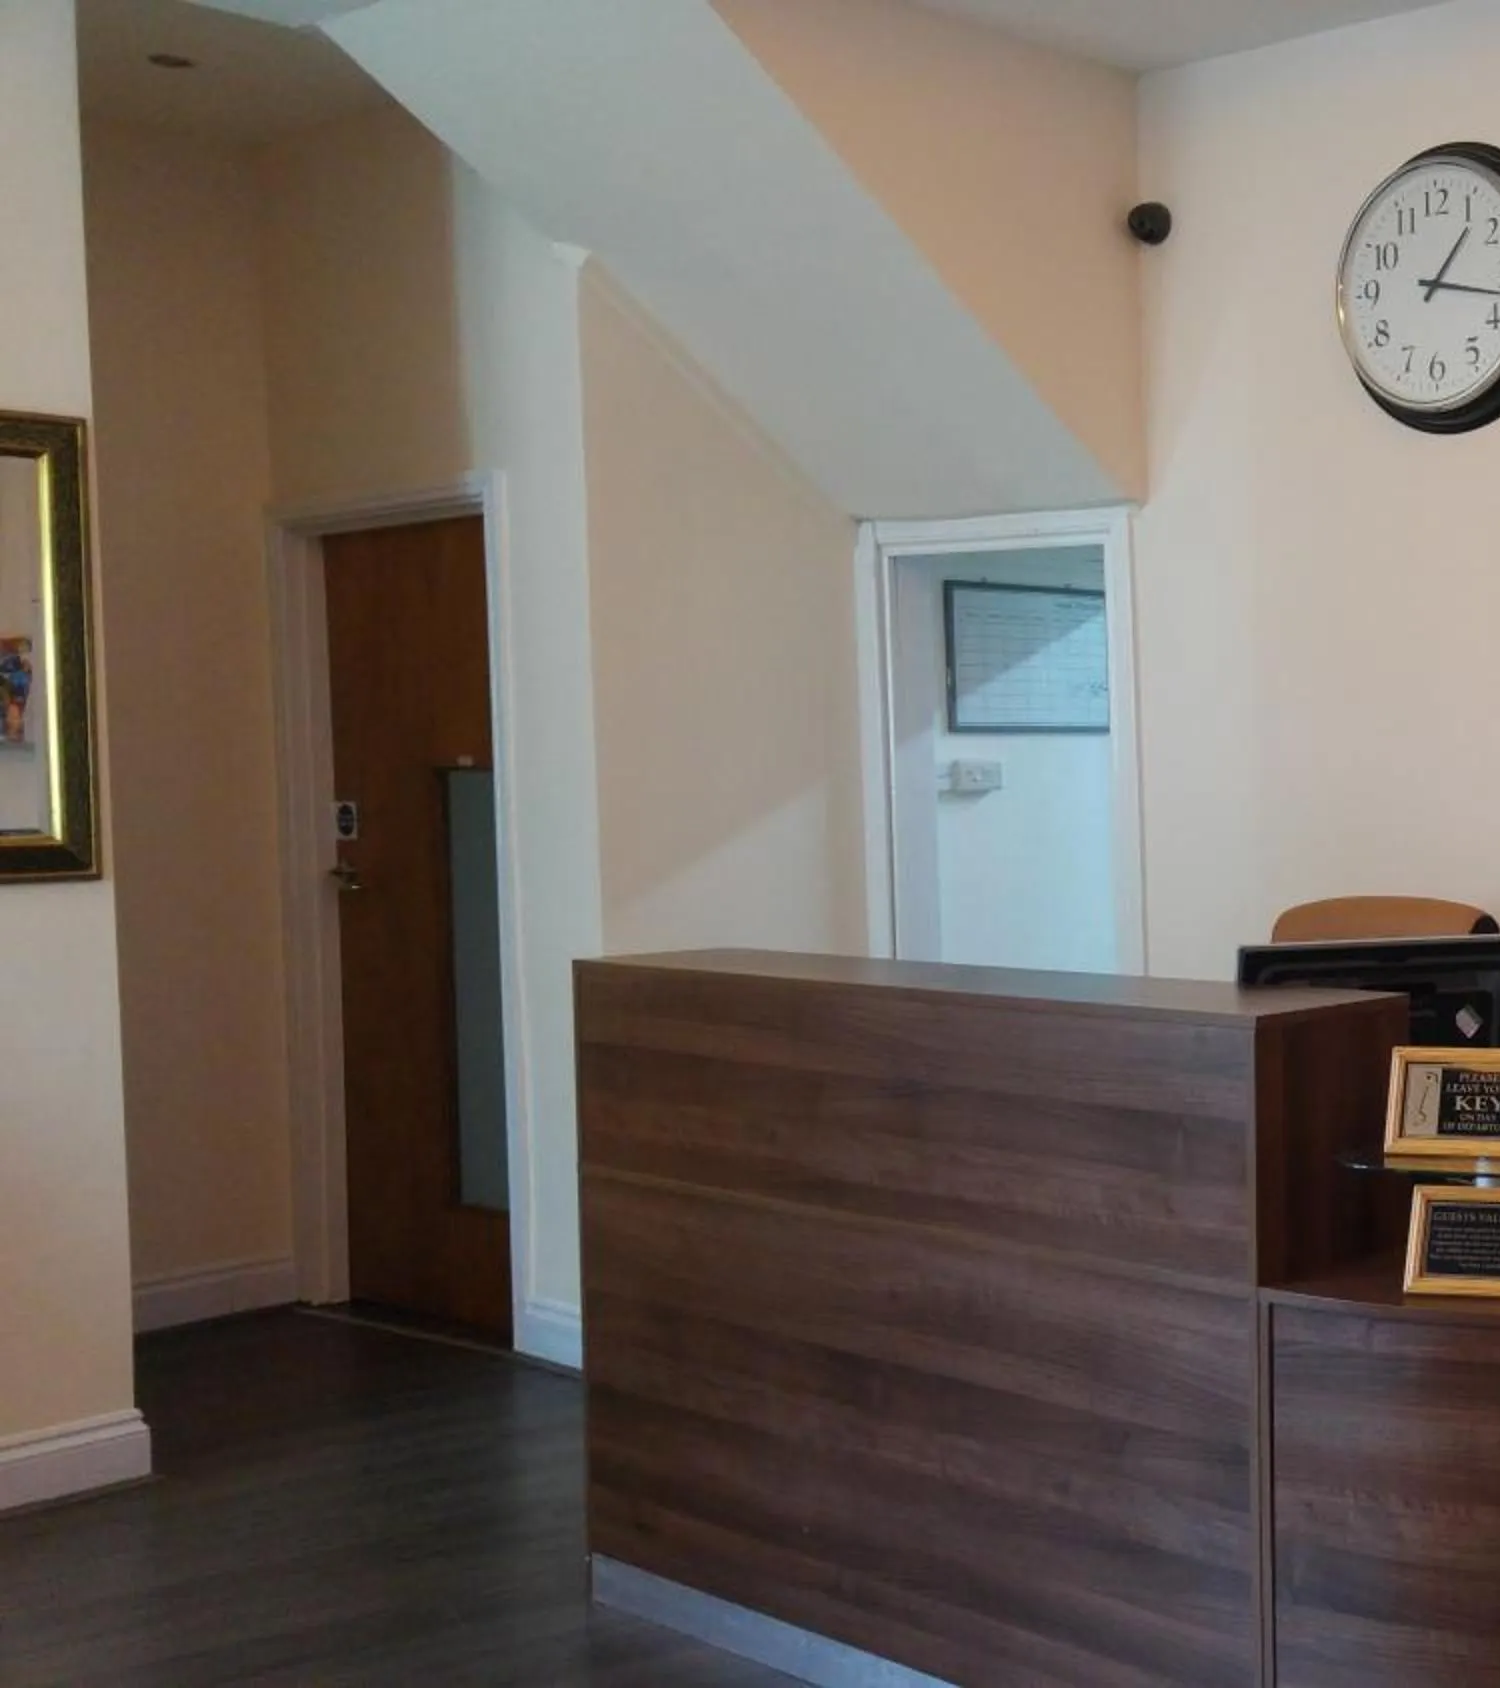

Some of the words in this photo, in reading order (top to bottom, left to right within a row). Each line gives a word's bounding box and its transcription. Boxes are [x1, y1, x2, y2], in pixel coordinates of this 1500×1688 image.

[1424, 188, 1449, 217] 12
[1465, 194, 1472, 222] 1
[1397, 206, 1416, 236] 11
[1485, 217, 1499, 245] 2
[1375, 242, 1399, 271] 10
[1363, 279, 1381, 309] 9
[1485, 302, 1500, 330] 4
[1374, 319, 1390, 348] 8
[1401, 345, 1415, 374] 7
[1465, 336, 1480, 366] 5
[1429, 352, 1446, 382] 6
[1445, 1083, 1480, 1093] LEAVE
[1459, 1072, 1500, 1083] PLEASE
